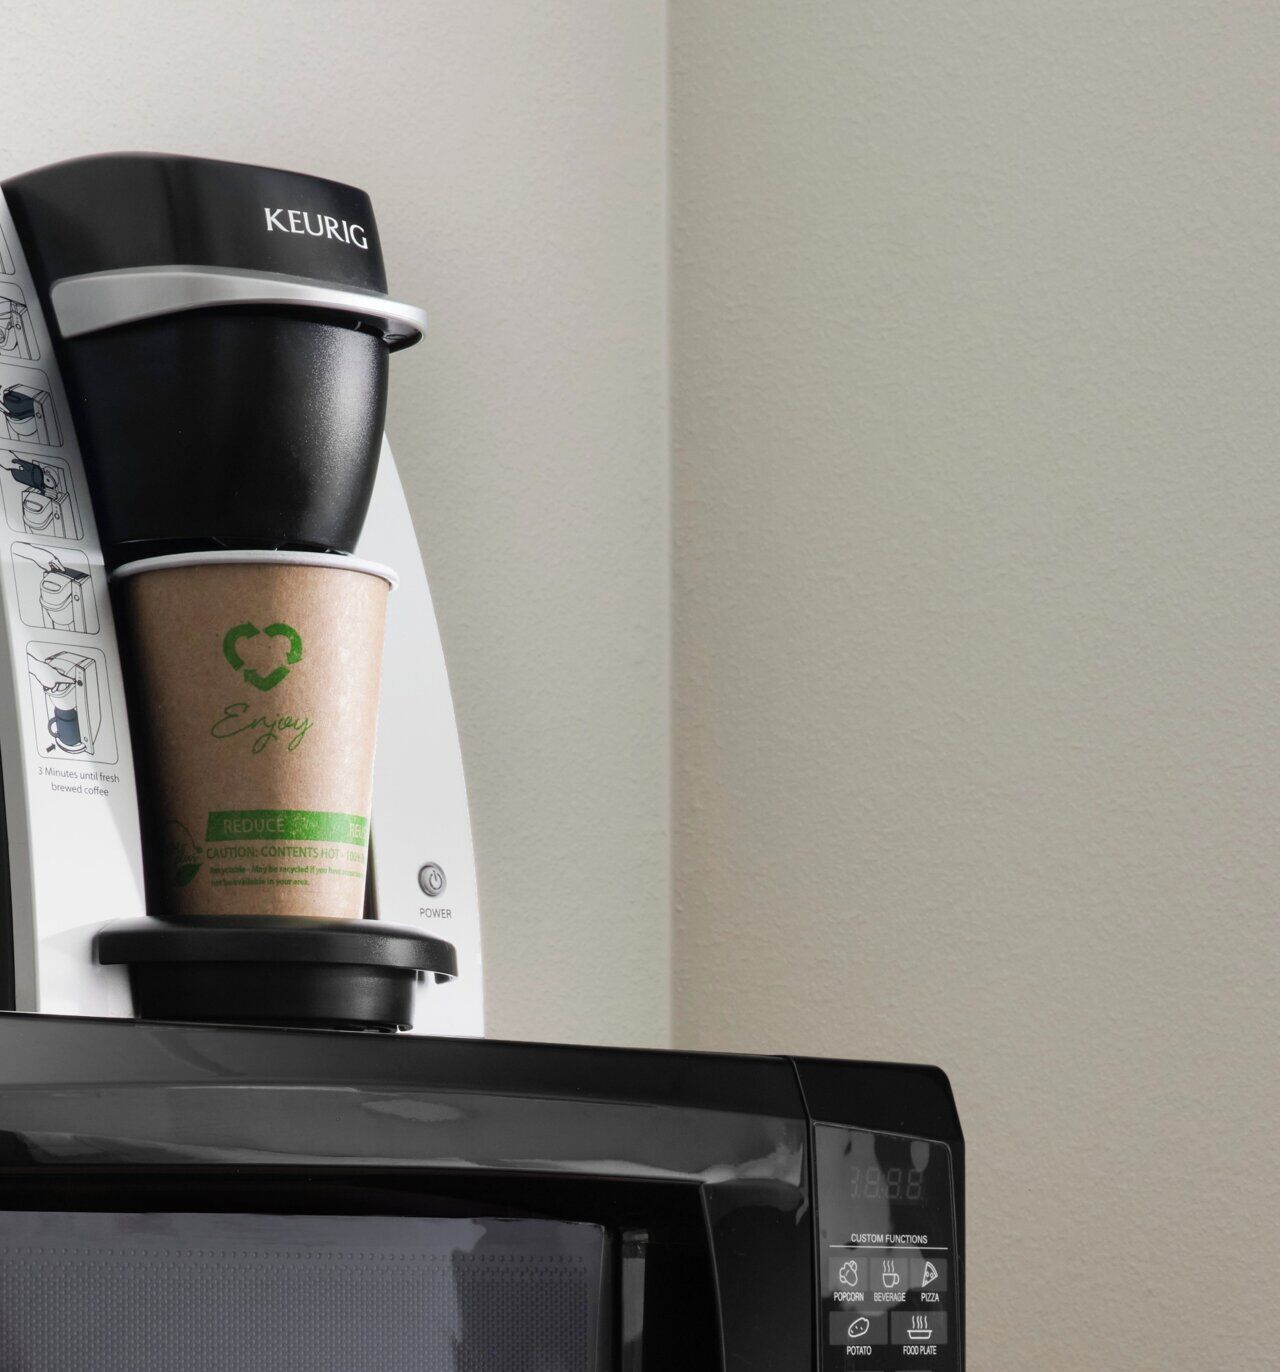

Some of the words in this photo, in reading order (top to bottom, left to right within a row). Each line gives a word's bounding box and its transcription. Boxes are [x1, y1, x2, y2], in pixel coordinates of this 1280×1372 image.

[264, 208, 368, 249] KEURIG
[211, 703, 313, 753] Enjoy
[38, 767, 43, 775] 3
[45, 768, 78, 779] Minutes
[80, 772, 98, 780] until
[100, 773, 120, 783] fresh
[51, 782, 82, 793] brewed
[84, 786, 109, 796] coffee
[223, 818, 285, 833] REDUCE
[206, 847, 258, 859] CAUTION:
[261, 846, 318, 859] CONTENTS
[321, 848, 340, 860] HOT
[279, 865, 309, 876] recycled
[420, 908, 452, 919] POWER
[850, 1233, 883, 1243] CUSTOM
[885, 1234, 928, 1244] FUNCTIONS
[833, 1291, 864, 1302] POPCORN
[873, 1292, 906, 1302] BEVERAGE
[921, 1293, 940, 1302] PIZZA
[846, 1345, 872, 1356] POTATO
[903, 1345, 919, 1355] FOOD
[919, 1345, 937, 1355] PLATE
